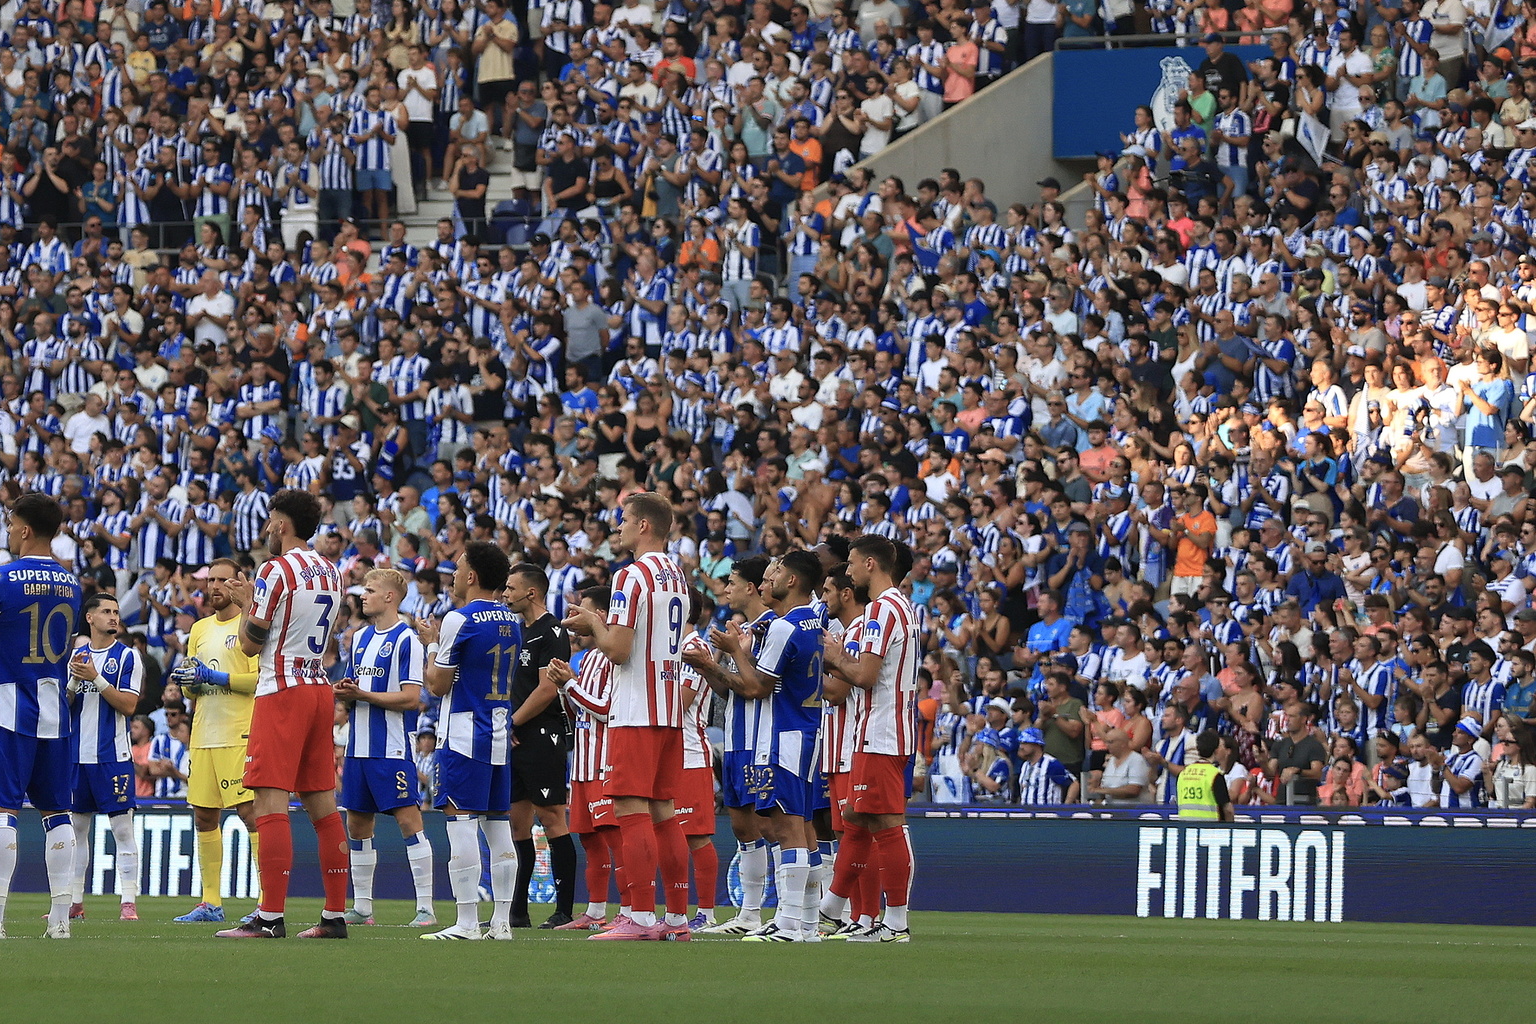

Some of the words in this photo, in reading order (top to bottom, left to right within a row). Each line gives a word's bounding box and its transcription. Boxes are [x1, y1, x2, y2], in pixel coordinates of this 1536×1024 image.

[8, 570, 50, 582] SUPER
[24, 583, 50, 595] GABRI
[54, 584, 74, 598] VEIGA
[307, 594, 334, 654] 3
[472, 610, 505, 624] SUPER
[668, 597, 682, 655] 9
[19, 602, 74, 664] 10
[485, 643, 516, 700] 11
[112, 774, 130, 795] 17
[396, 771, 408, 791] 8
[1184, 787, 1203, 799] 293
[674, 807, 693, 815] mAve
